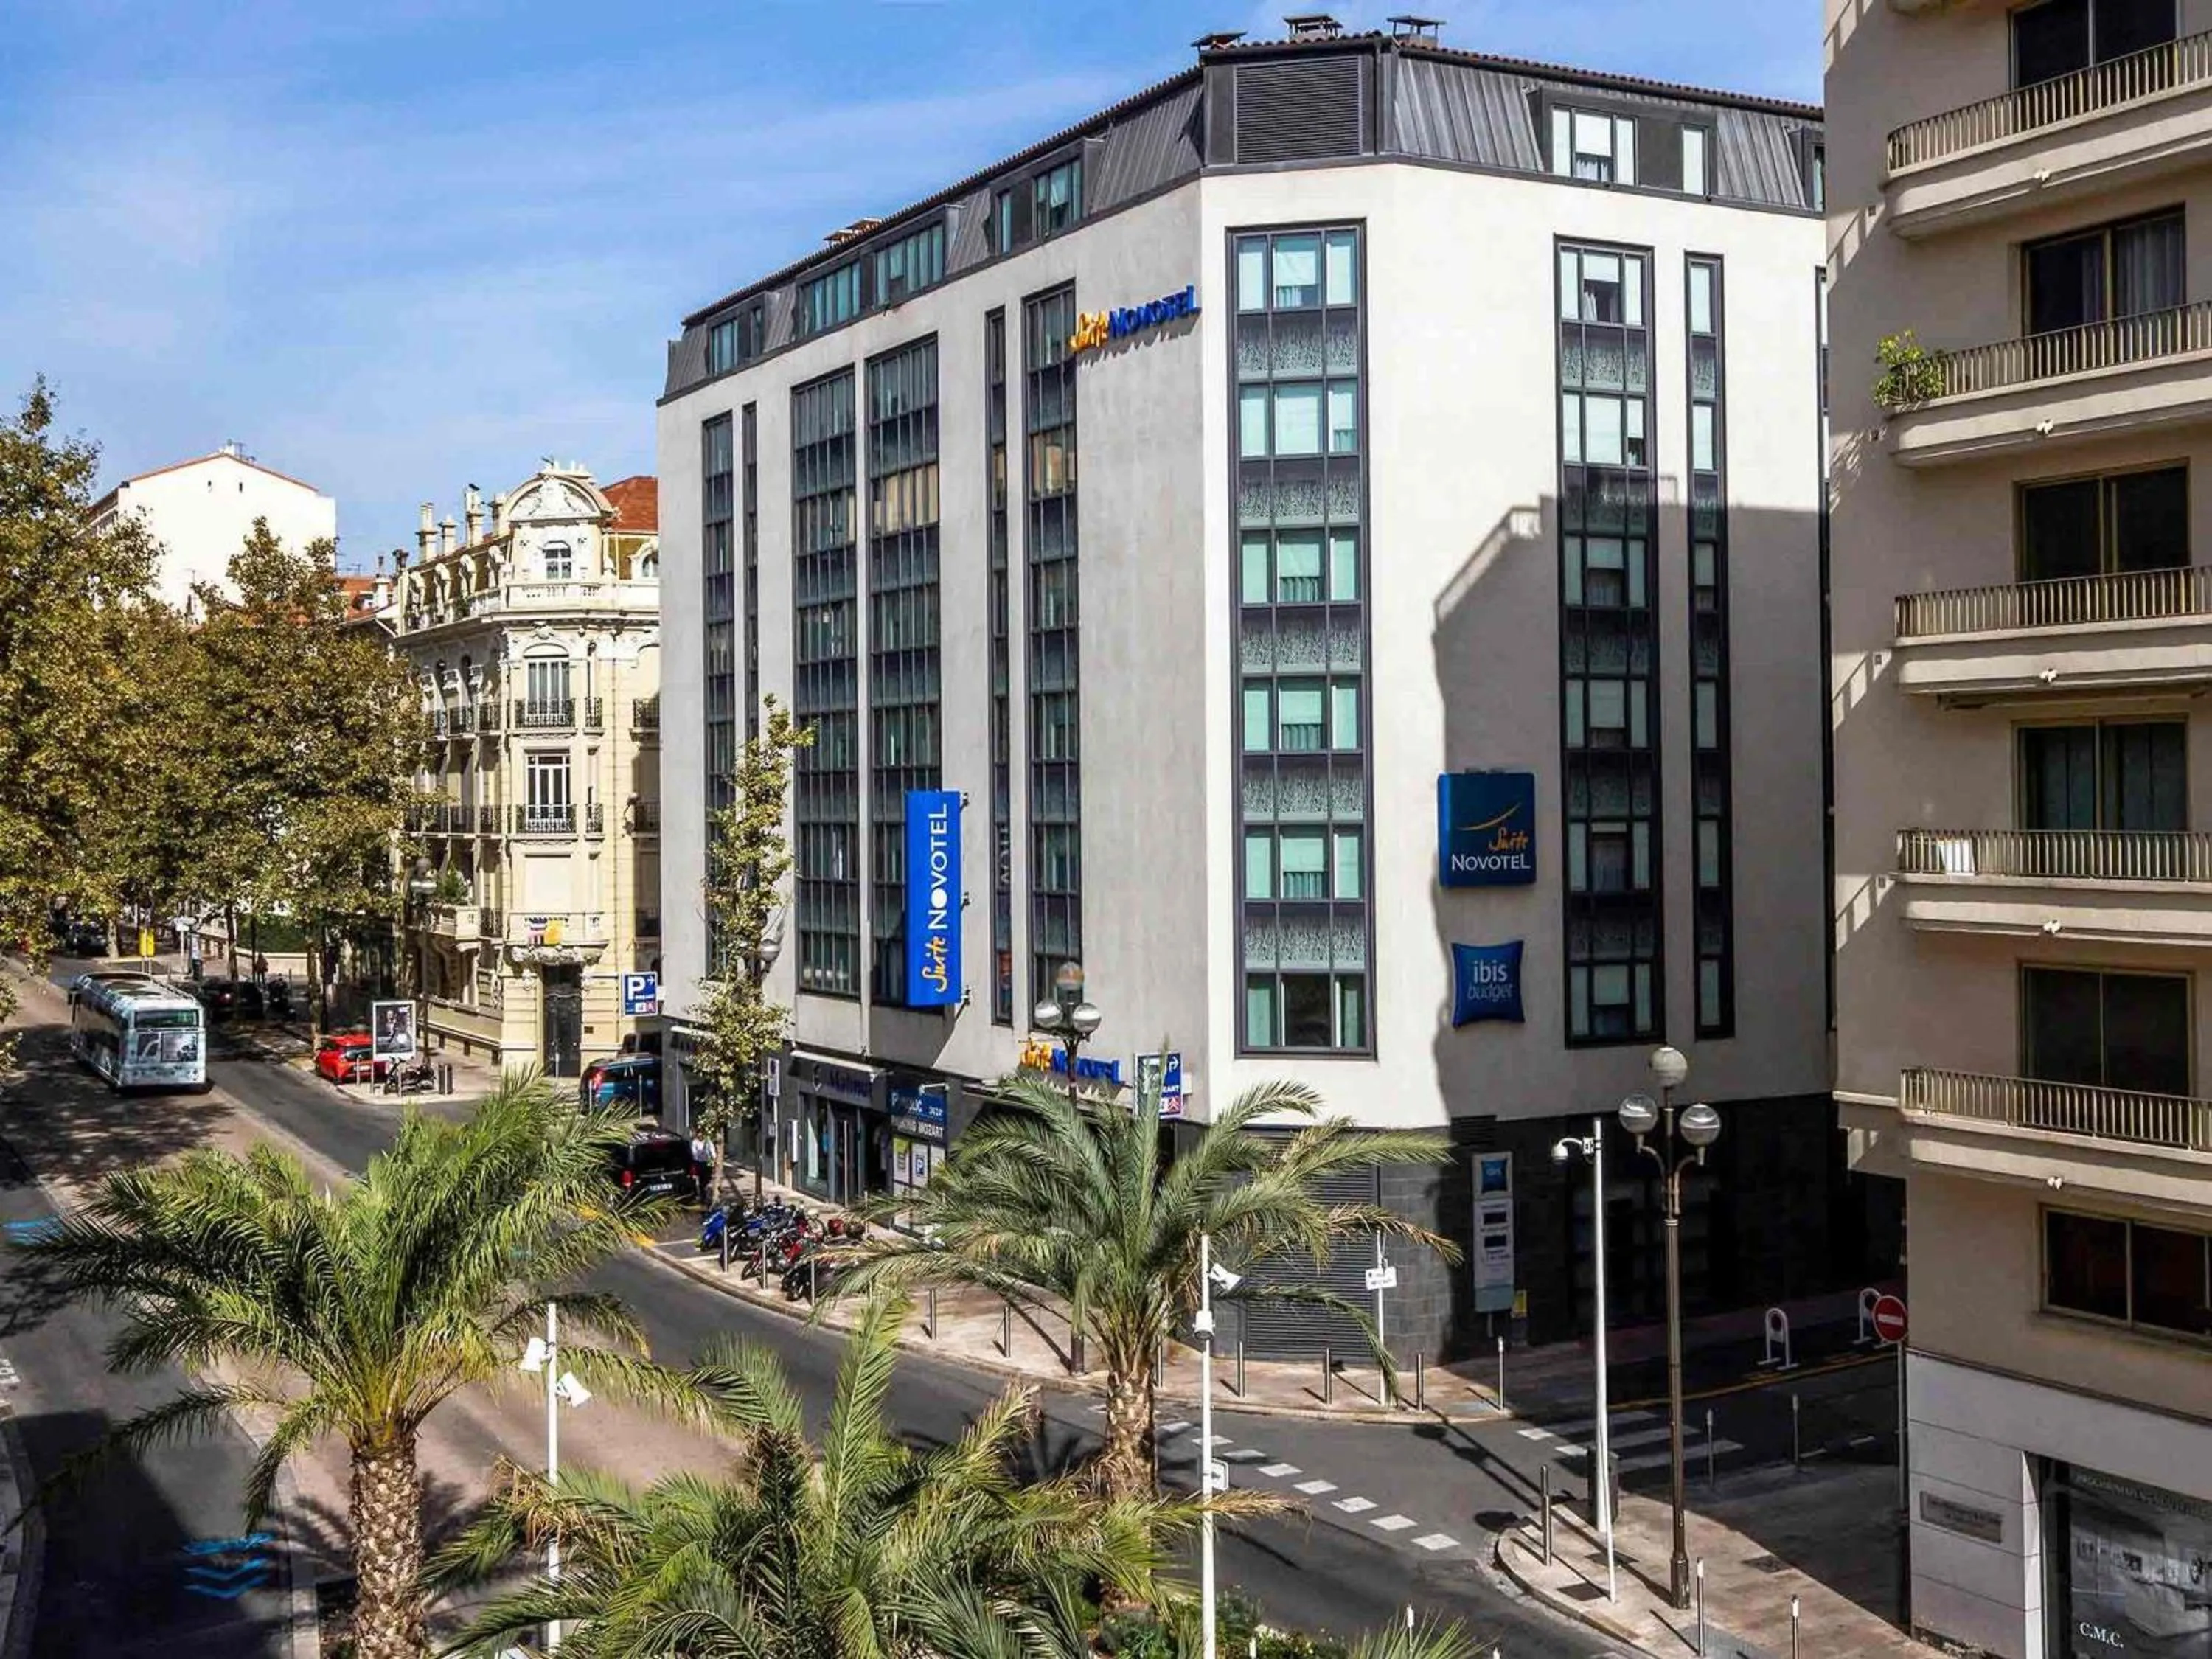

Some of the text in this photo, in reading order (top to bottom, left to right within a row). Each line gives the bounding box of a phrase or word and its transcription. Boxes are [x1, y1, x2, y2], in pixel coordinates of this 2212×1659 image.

[928, 804, 948, 930] NOVOTEL
[1450, 853, 1531, 872] NOVOTEL
[1473, 959, 1508, 984] ibis
[628, 976, 646, 1001] P
[2080, 1622, 2124, 1649] C.M.C.
